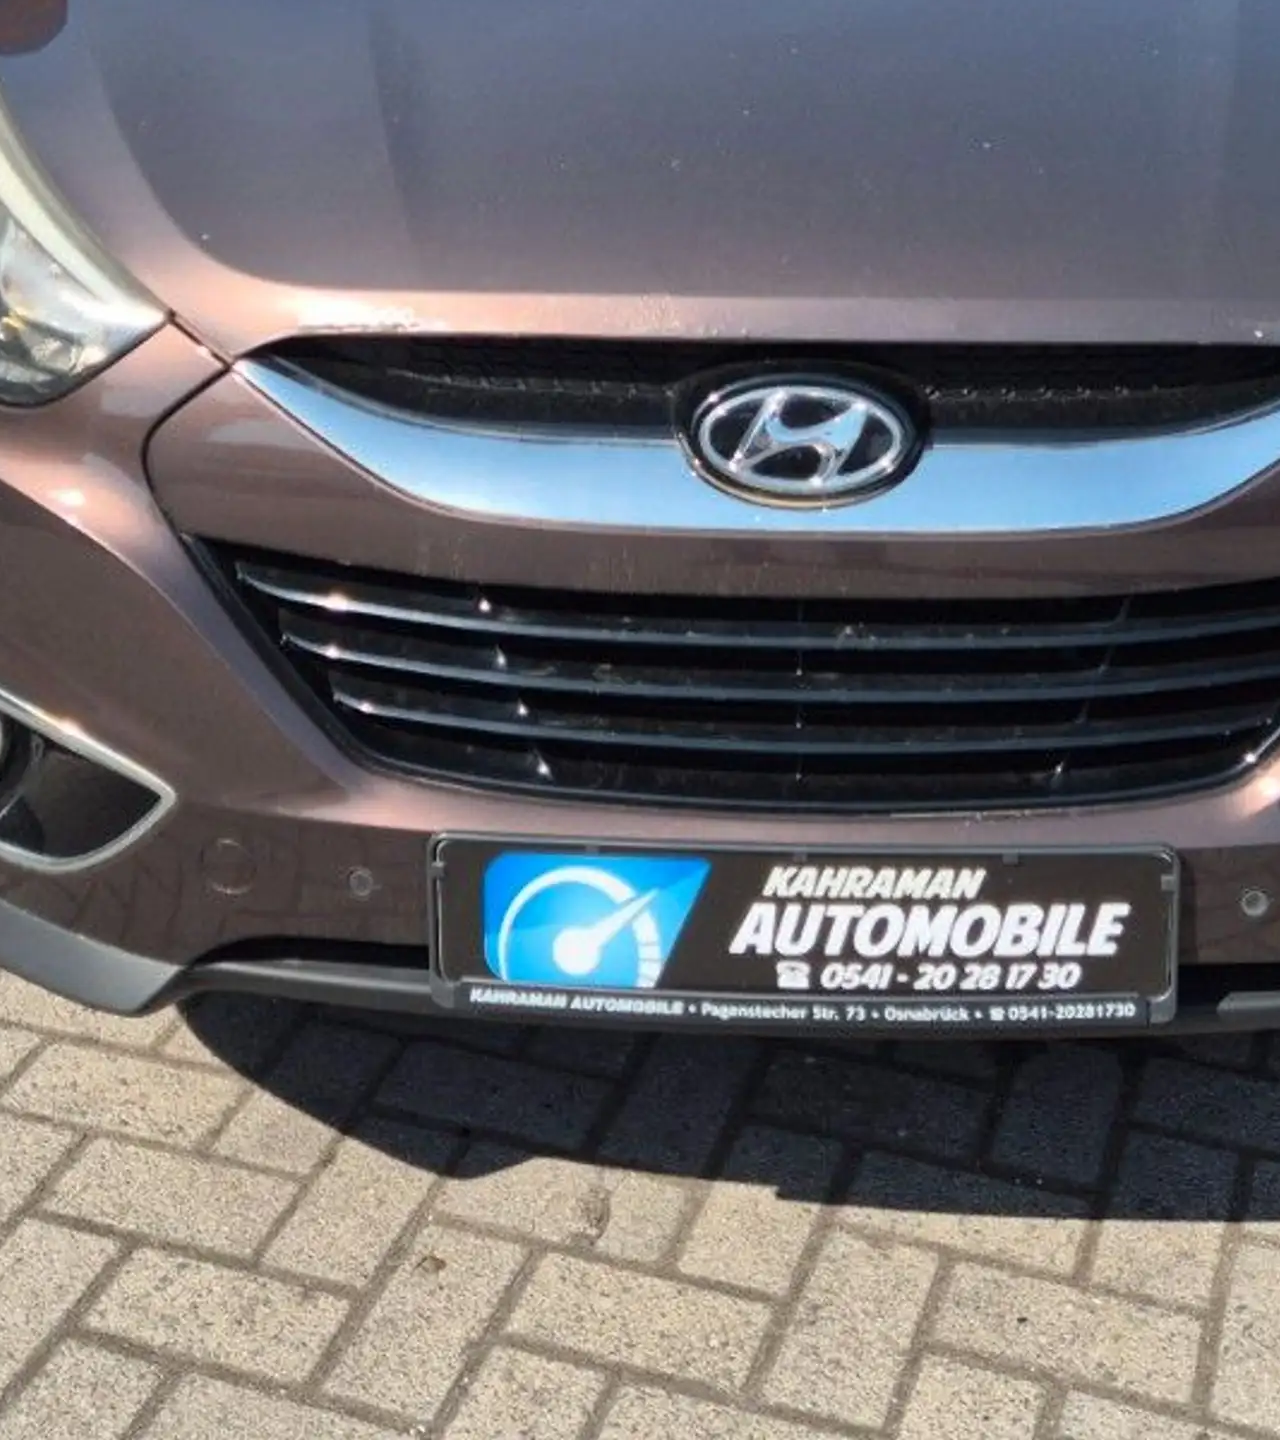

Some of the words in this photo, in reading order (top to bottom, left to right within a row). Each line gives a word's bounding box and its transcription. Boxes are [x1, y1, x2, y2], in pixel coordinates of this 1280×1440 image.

[761, 865, 988, 899] KAHRAMAN
[728, 900, 1132, 958] AUTOMOBILE
[821, 963, 893, 991] 0541
[913, 963, 957, 991] 20
[959, 963, 1002, 991] 28
[1004, 963, 1036, 991] 17
[1037, 963, 1082, 991] 30
[470, 987, 567, 1010] KAHRAMAN
[569, 995, 684, 1016] AUTOMOBILE
[811, 1003, 841, 1022] Str.
[845, 1005, 866, 1022] 73
[884, 1003, 970, 1022] Osnabrück
